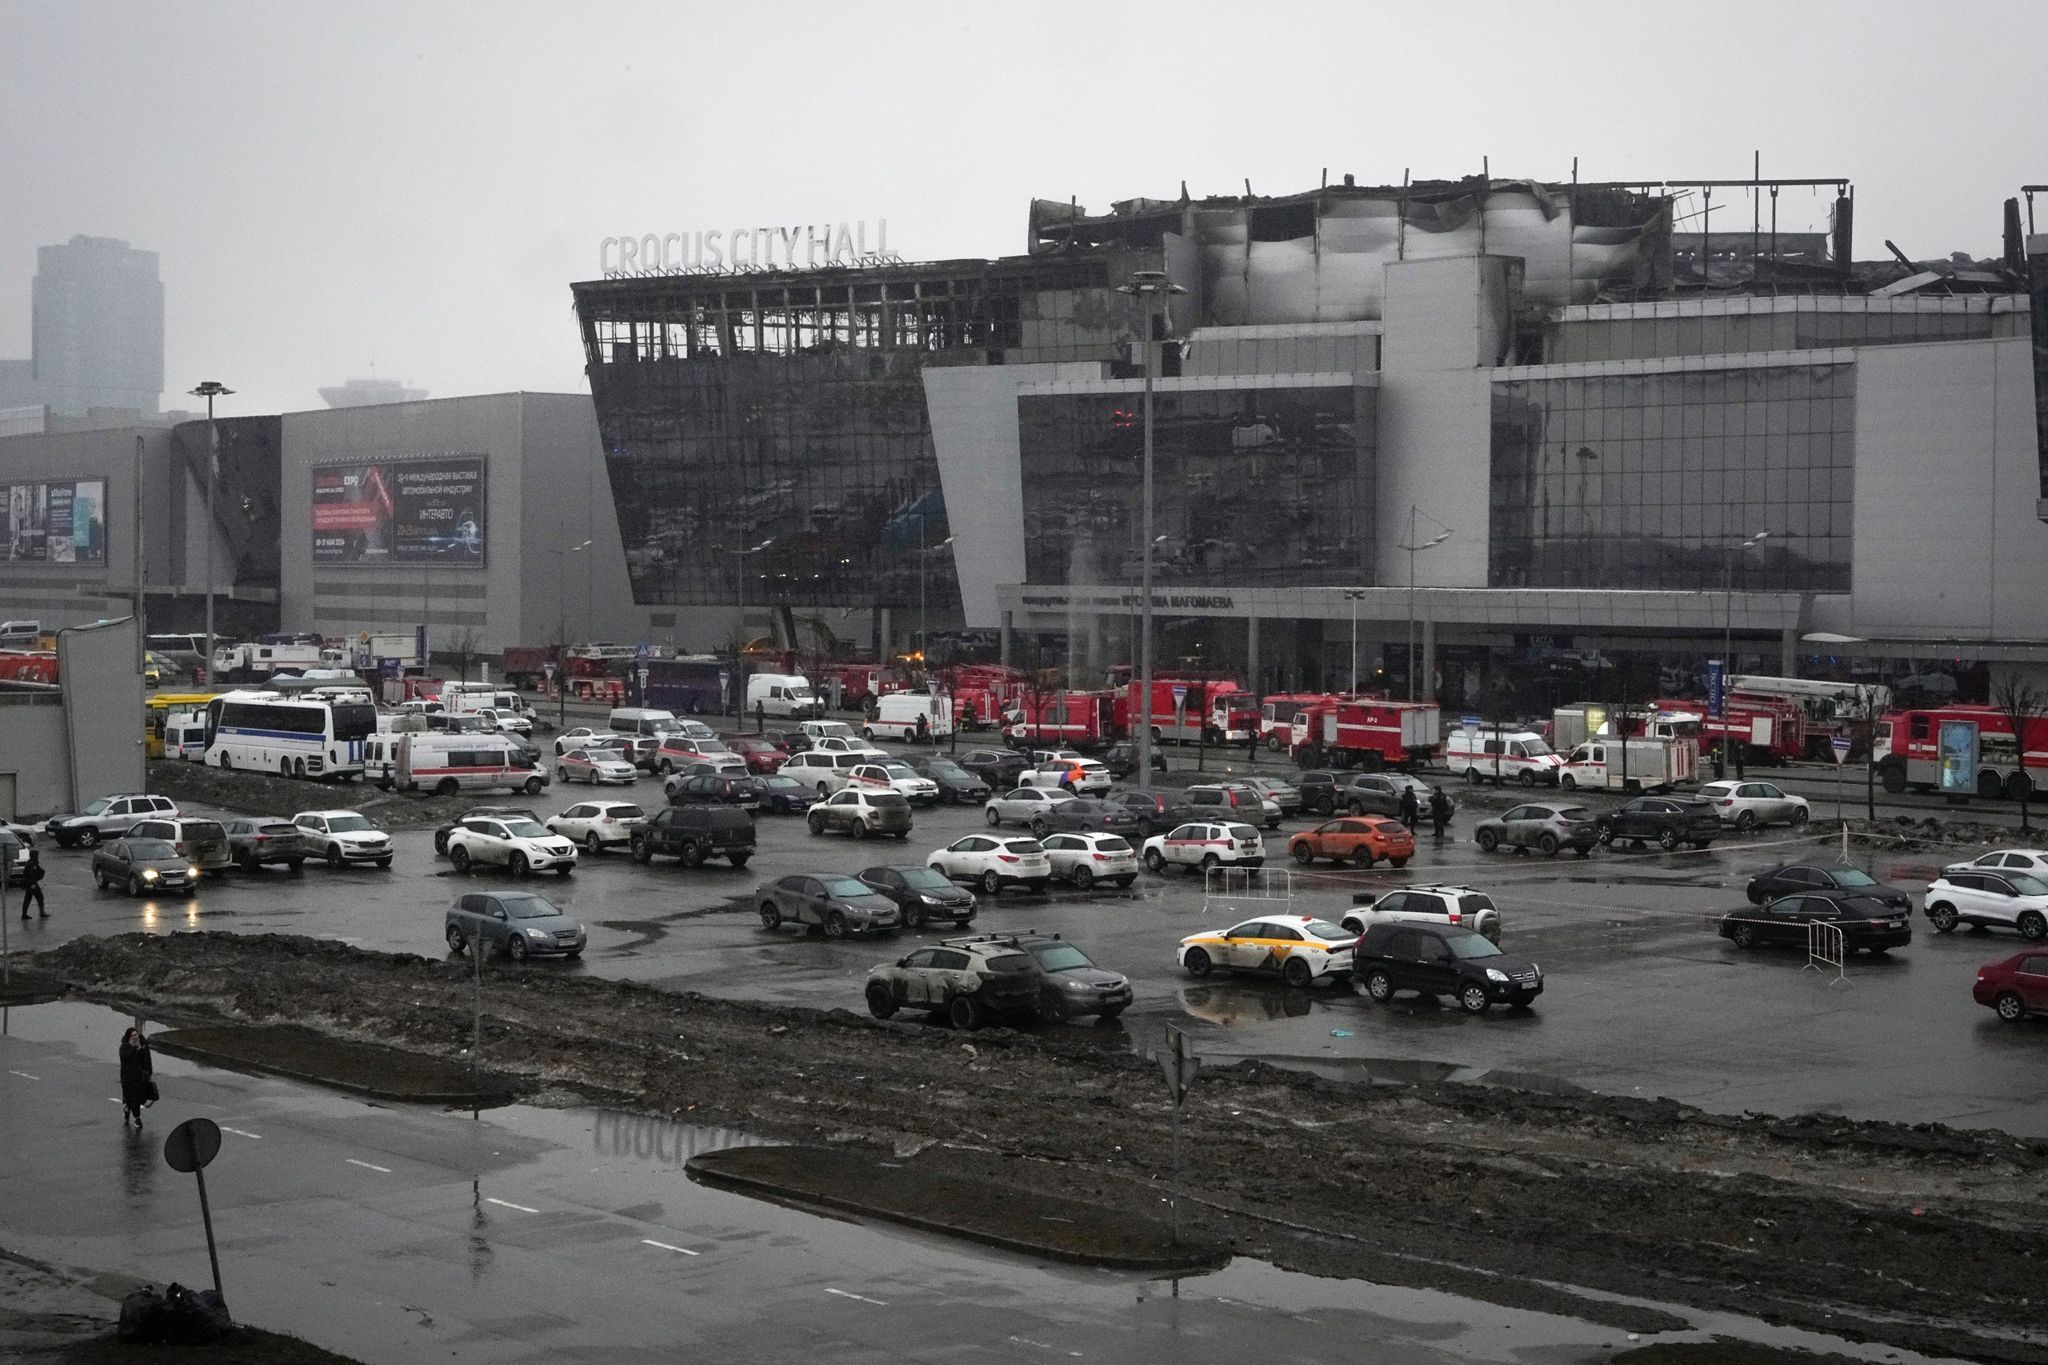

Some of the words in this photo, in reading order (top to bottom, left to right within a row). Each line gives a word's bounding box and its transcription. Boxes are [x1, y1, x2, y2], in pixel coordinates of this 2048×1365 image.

[599, 230, 724, 275] CROCUS
[729, 226, 802, 266] CITY
[807, 218, 899, 264] HALL
